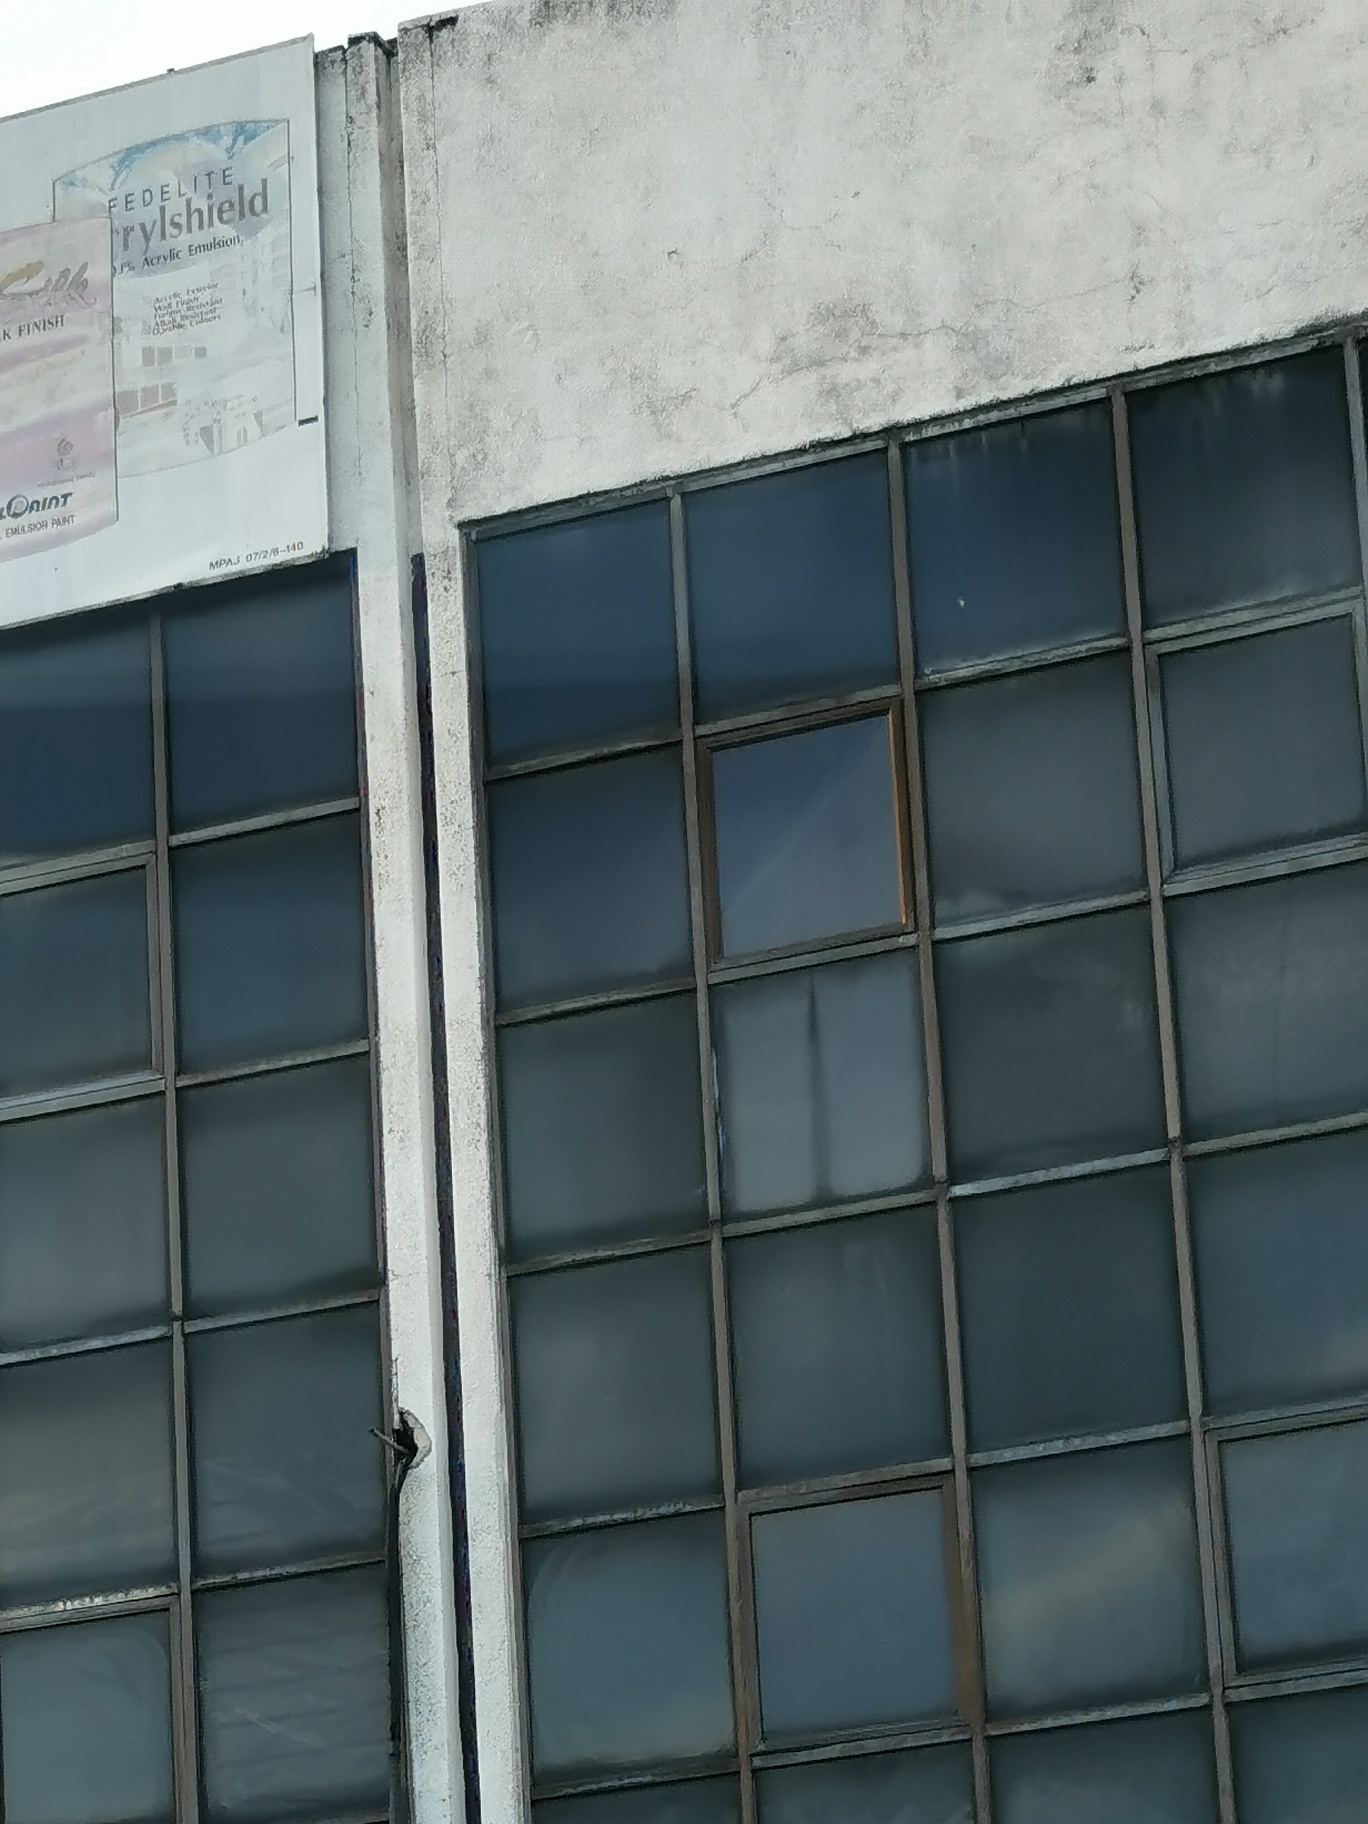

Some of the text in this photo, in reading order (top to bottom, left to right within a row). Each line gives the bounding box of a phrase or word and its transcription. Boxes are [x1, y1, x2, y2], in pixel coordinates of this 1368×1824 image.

[109, 167, 234, 215] FEDELITE
[113, 178, 269, 256] rylshield
[18, 314, 65, 338] FINISH
[51, 514, 75, 530] PAINT
